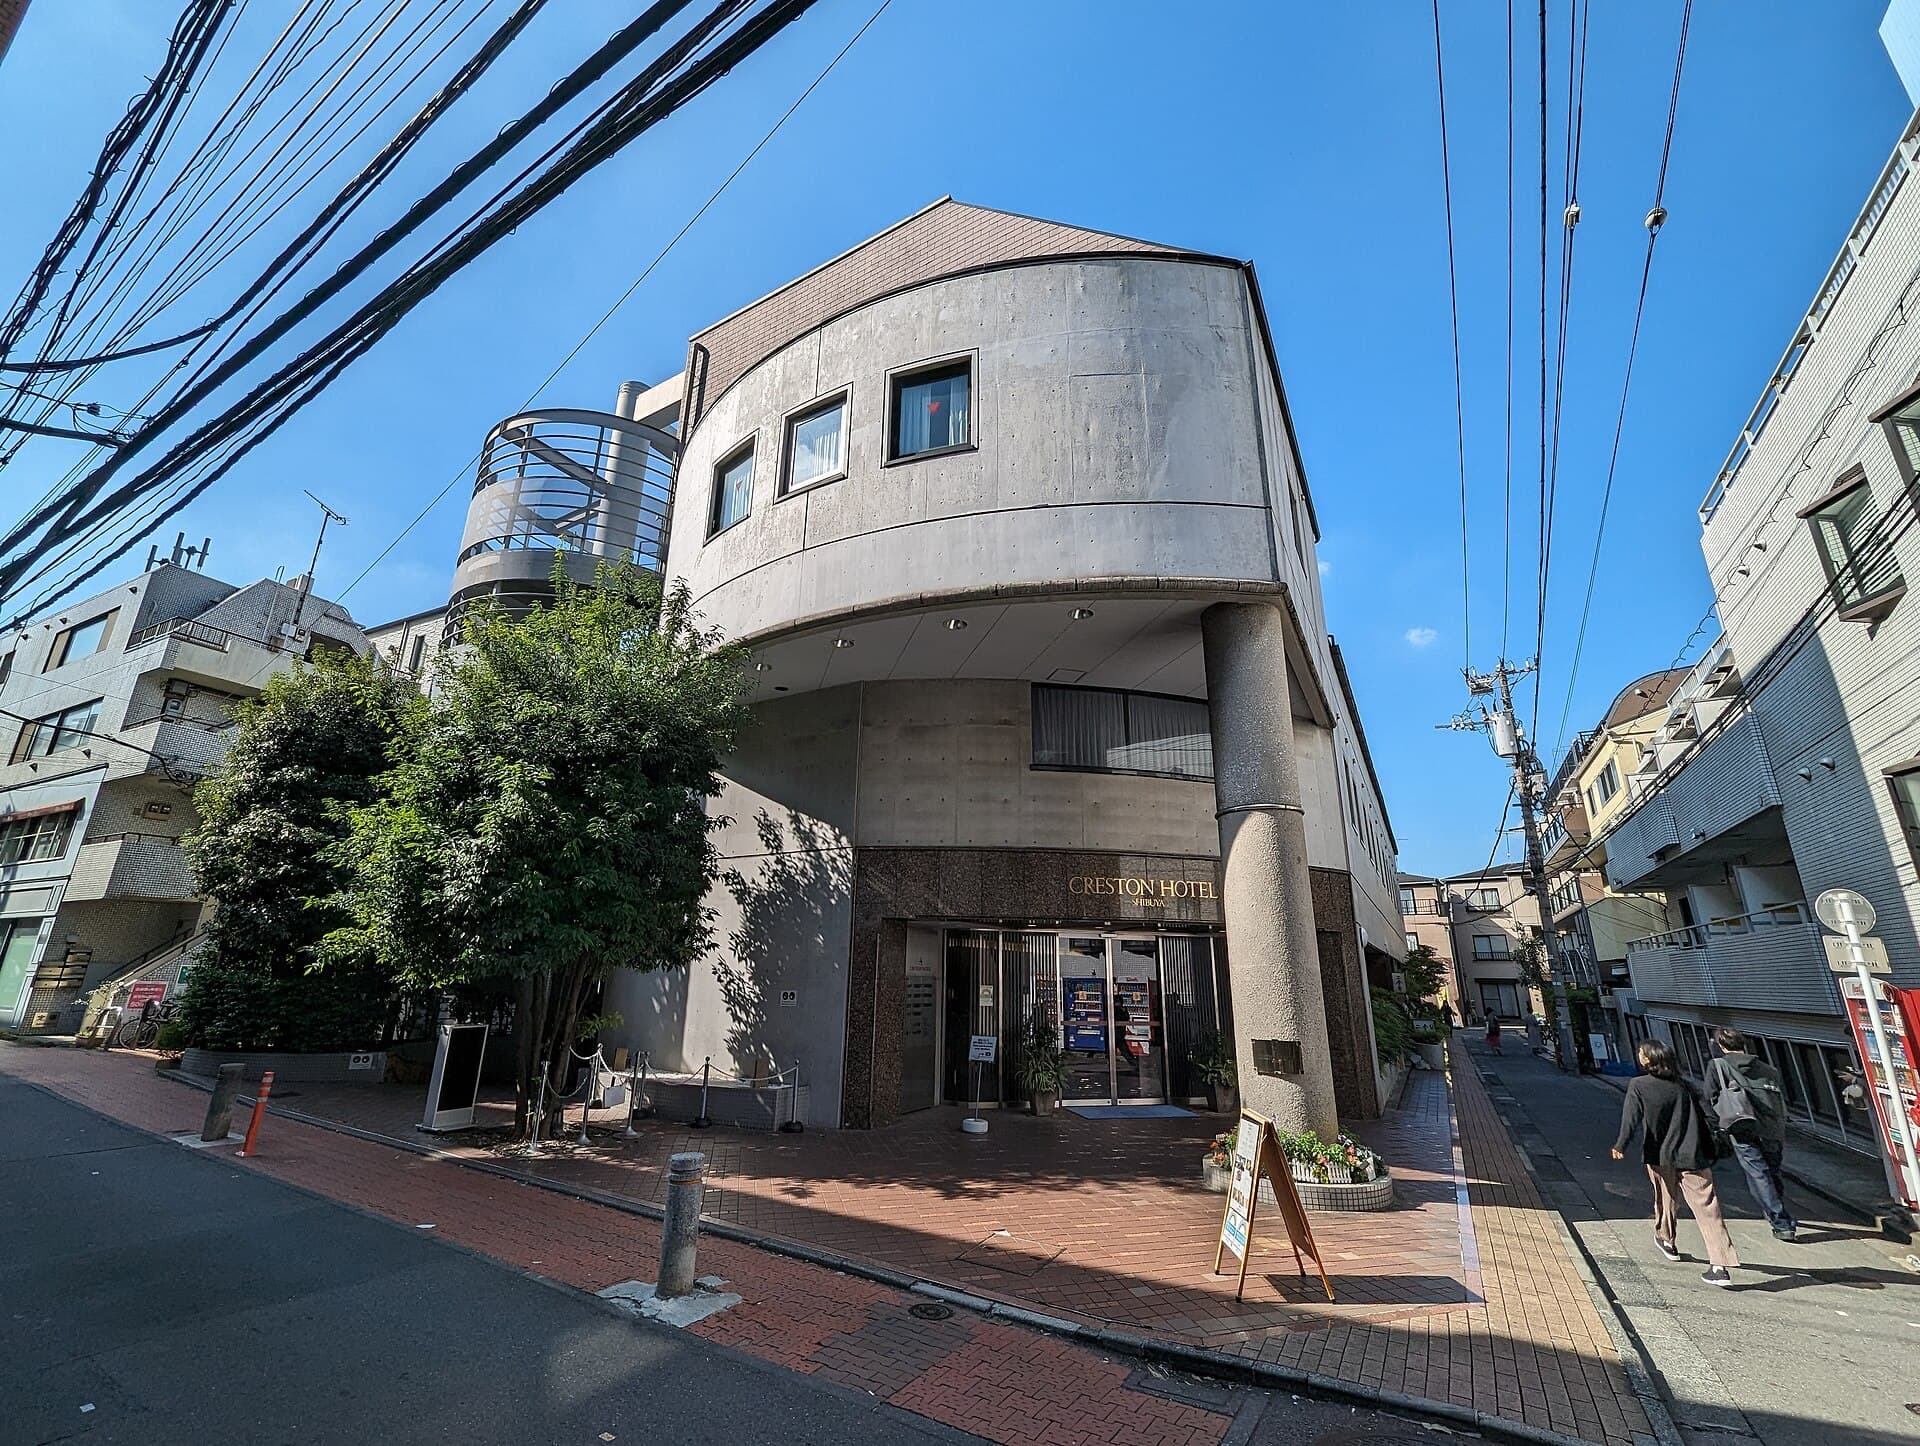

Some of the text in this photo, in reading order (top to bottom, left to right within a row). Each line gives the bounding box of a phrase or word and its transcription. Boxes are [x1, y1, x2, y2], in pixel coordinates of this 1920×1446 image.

[1069, 876, 1218, 899] CRESTON HOTEL
[1132, 898, 1165, 908] SHIBUYA
